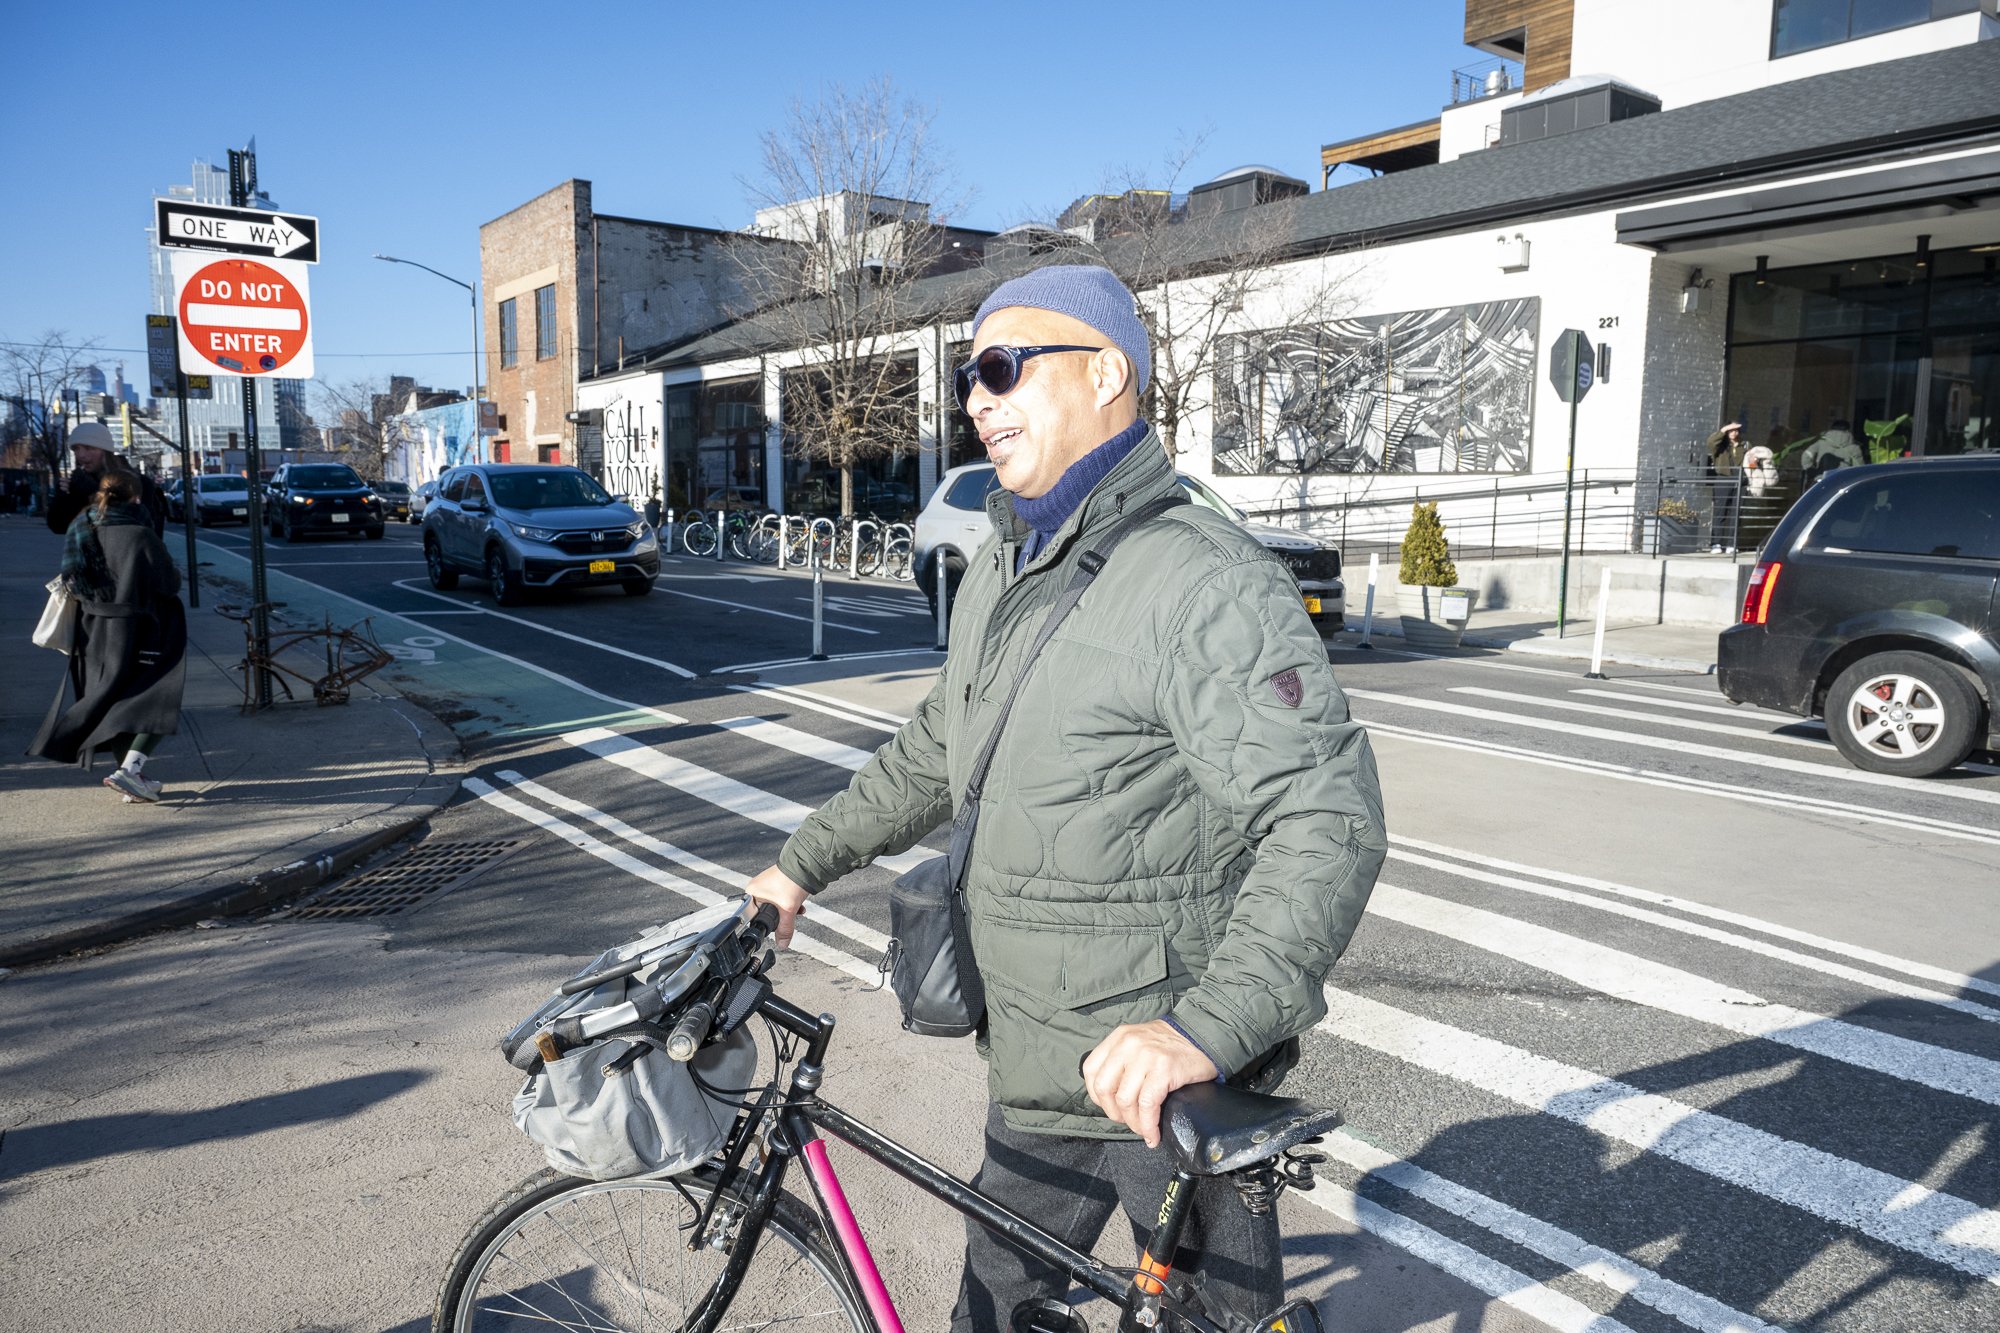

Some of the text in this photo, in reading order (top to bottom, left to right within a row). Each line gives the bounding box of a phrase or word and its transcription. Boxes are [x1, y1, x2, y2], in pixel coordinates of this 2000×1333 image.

[183, 218, 294, 246] ONE WAY
[200, 279, 284, 302] DO NOT
[1598, 316, 1620, 329] 221
[210, 332, 283, 353] ENTER
[606, 466, 651, 497] MOM
[1274, 673, 1296, 686] POLO
